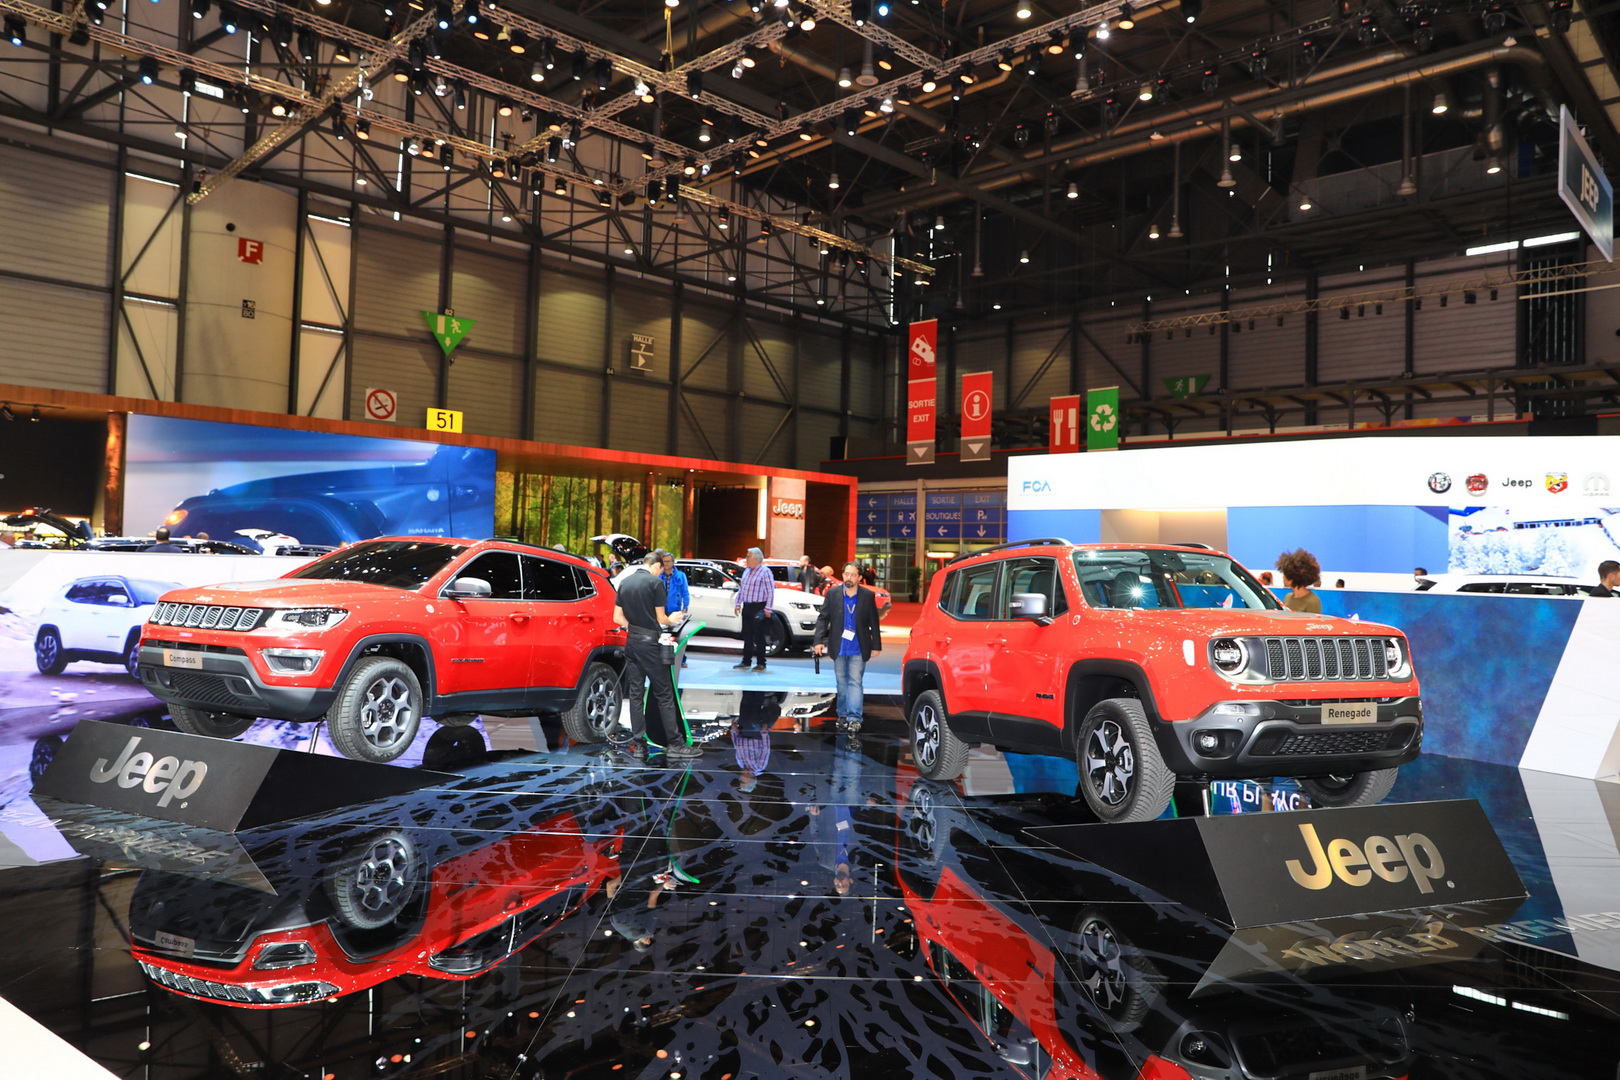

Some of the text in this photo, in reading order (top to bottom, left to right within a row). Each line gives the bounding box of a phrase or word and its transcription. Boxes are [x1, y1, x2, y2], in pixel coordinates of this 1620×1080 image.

[1580, 163, 1599, 213] JEEP
[245, 240, 259, 257] F
[633, 335, 653, 345] HALLE
[640, 343, 646, 353] 7
[908, 398, 936, 409] SORTIE
[436, 411, 454, 430] 51
[913, 413, 930, 423] EXIT
[1022, 480, 1052, 493] FCA
[1501, 477, 1533, 489] Jeep
[894, 498, 915, 506] HALLE
[931, 495, 991, 505] SORTIE EXIT
[772, 499, 804, 518] Jeep
[926, 511, 961, 521] BOUTIQUES
[169, 654, 196, 665] Compass
[1328, 707, 1371, 719] Renegade
[89, 736, 208, 808] Jeep
[1285, 823, 1446, 894] Jeep
[1281, 932, 1460, 966] WORLD
